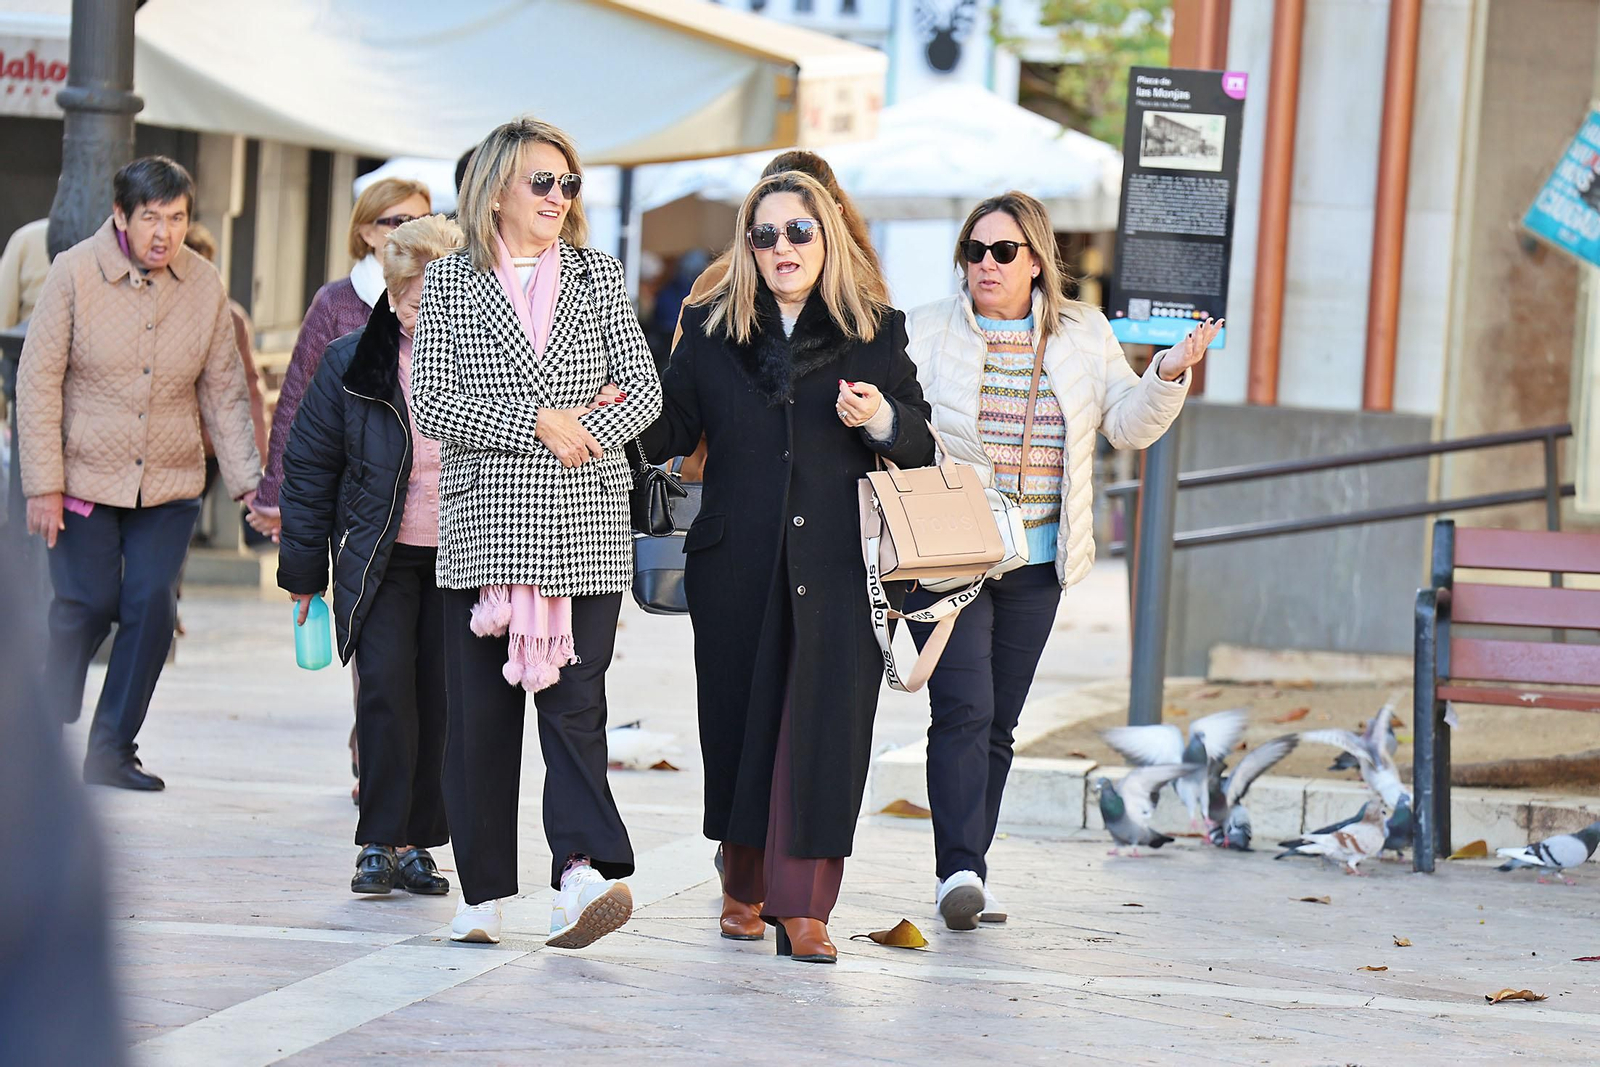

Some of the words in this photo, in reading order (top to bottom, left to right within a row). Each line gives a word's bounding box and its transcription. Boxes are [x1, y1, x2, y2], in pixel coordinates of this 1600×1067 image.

[0, 50, 69, 82] aho
[1136, 86, 1152, 97] las
[1153, 87, 1191, 101] Monjas
[915, 514, 973, 532] TOUS
[869, 564, 882, 605] TOUS
[948, 586, 980, 608] TOU
[874, 610, 884, 629] TO
[883, 649, 898, 685] TOUS
